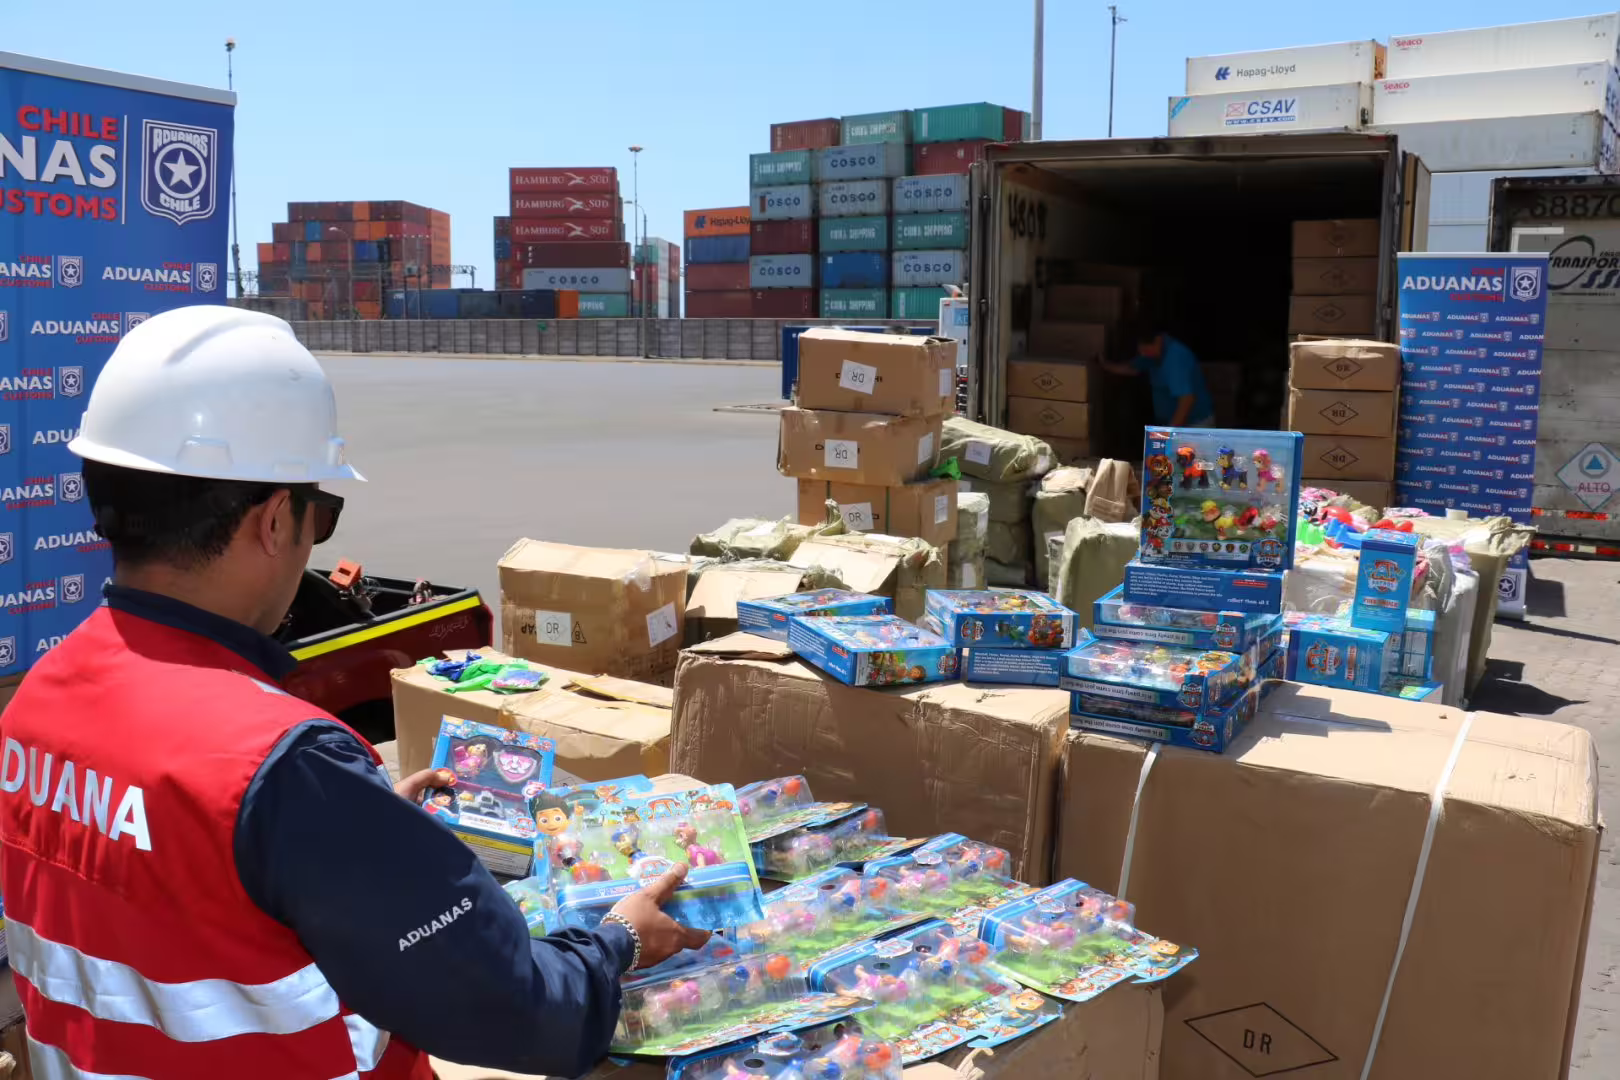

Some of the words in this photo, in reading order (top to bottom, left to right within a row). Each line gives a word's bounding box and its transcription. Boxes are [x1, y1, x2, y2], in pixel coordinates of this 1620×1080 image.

[1236, 64, 1296, 78] Hapag-Lloyd
[1384, 82, 1410, 90] seaco
[1247, 98, 1296, 116] CSAV
[17, 105, 118, 141] CHILE
[152, 127, 208, 158] ADUANAS
[831, 156, 876, 168] COSCO
[515, 176, 565, 185] HAMBURG
[831, 192, 876, 203] COSCO
[904, 188, 952, 199] COSCO
[0, 188, 117, 221] STOMS
[159, 193, 201, 211] CHILE
[515, 200, 565, 209] HAMBURG
[760, 196, 800, 208] OSCO
[515, 225, 565, 235] HAMBURG
[760, 266, 801, 275] COSCO
[904, 263, 952, 272] COSCO
[102, 266, 191, 283] ADUANAS
[549, 276, 599, 284] COSCO
[1402, 276, 1503, 291] ADUANAS
[31, 320, 119, 335] ADUANAS
[851, 371, 865, 384] DR
[835, 447, 848, 460] DR
[0, 484, 53, 501] ANAS
[1578, 482, 1611, 493] ALTO
[848, 512, 863, 523] DR
[34, 530, 103, 550] ADUAN
[546, 622, 560, 634] DR
[0, 736, 152, 852] DUANA
[398, 896, 474, 952] ADUANAS
[1243, 1028, 1273, 1055] DR
